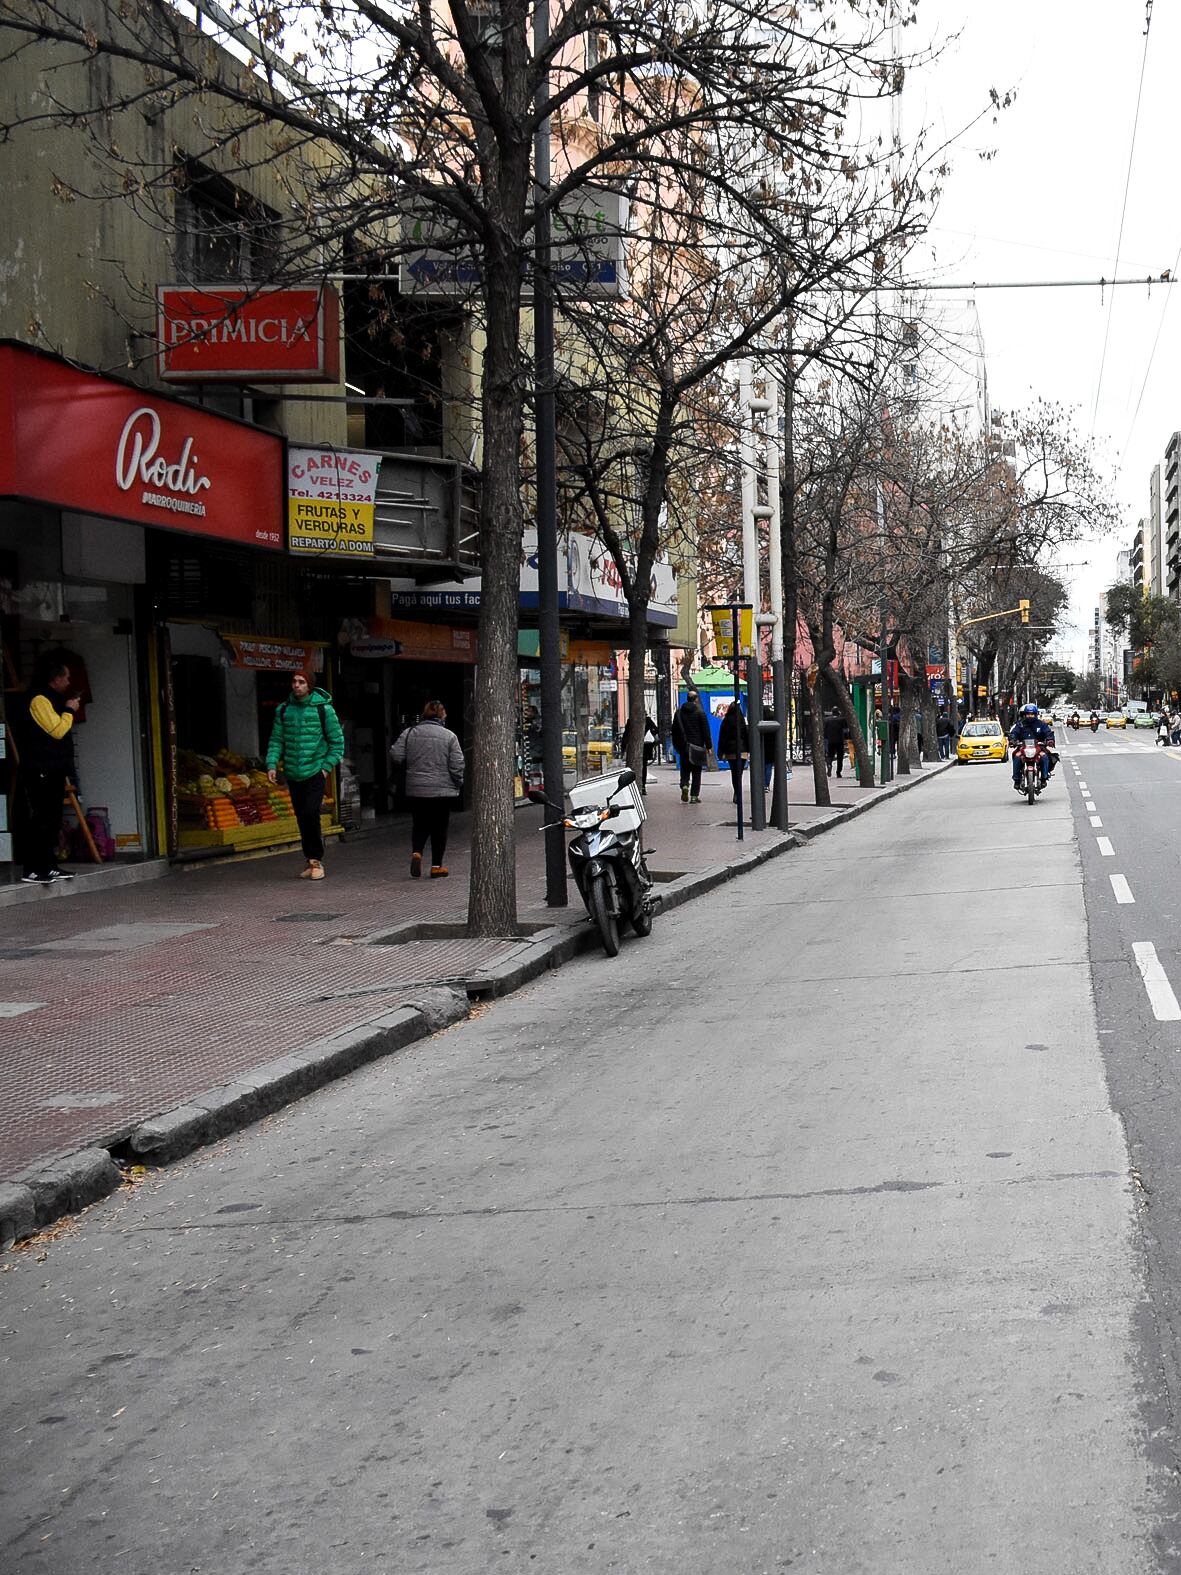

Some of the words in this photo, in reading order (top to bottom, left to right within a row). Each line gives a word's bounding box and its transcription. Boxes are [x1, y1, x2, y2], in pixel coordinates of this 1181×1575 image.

[170, 317, 310, 343] PRIMICIA
[116, 407, 211, 494] Rodi
[291, 455, 372, 484] CARNES
[310, 476, 354, 488] VELEZ
[289, 488, 313, 498] Tel.
[317, 491, 372, 502] 4213324
[298, 504, 346, 519] FRUTAS
[352, 509, 360, 520] Y
[295, 519, 366, 535] VERDURAS
[292, 537, 337, 549] REPARTO
[340, 540, 347, 550] A
[392, 592, 417, 607] Pagá
[420, 592, 442, 607] aquí
[445, 594, 461, 605] tus
[464, 593, 481, 605] fac
